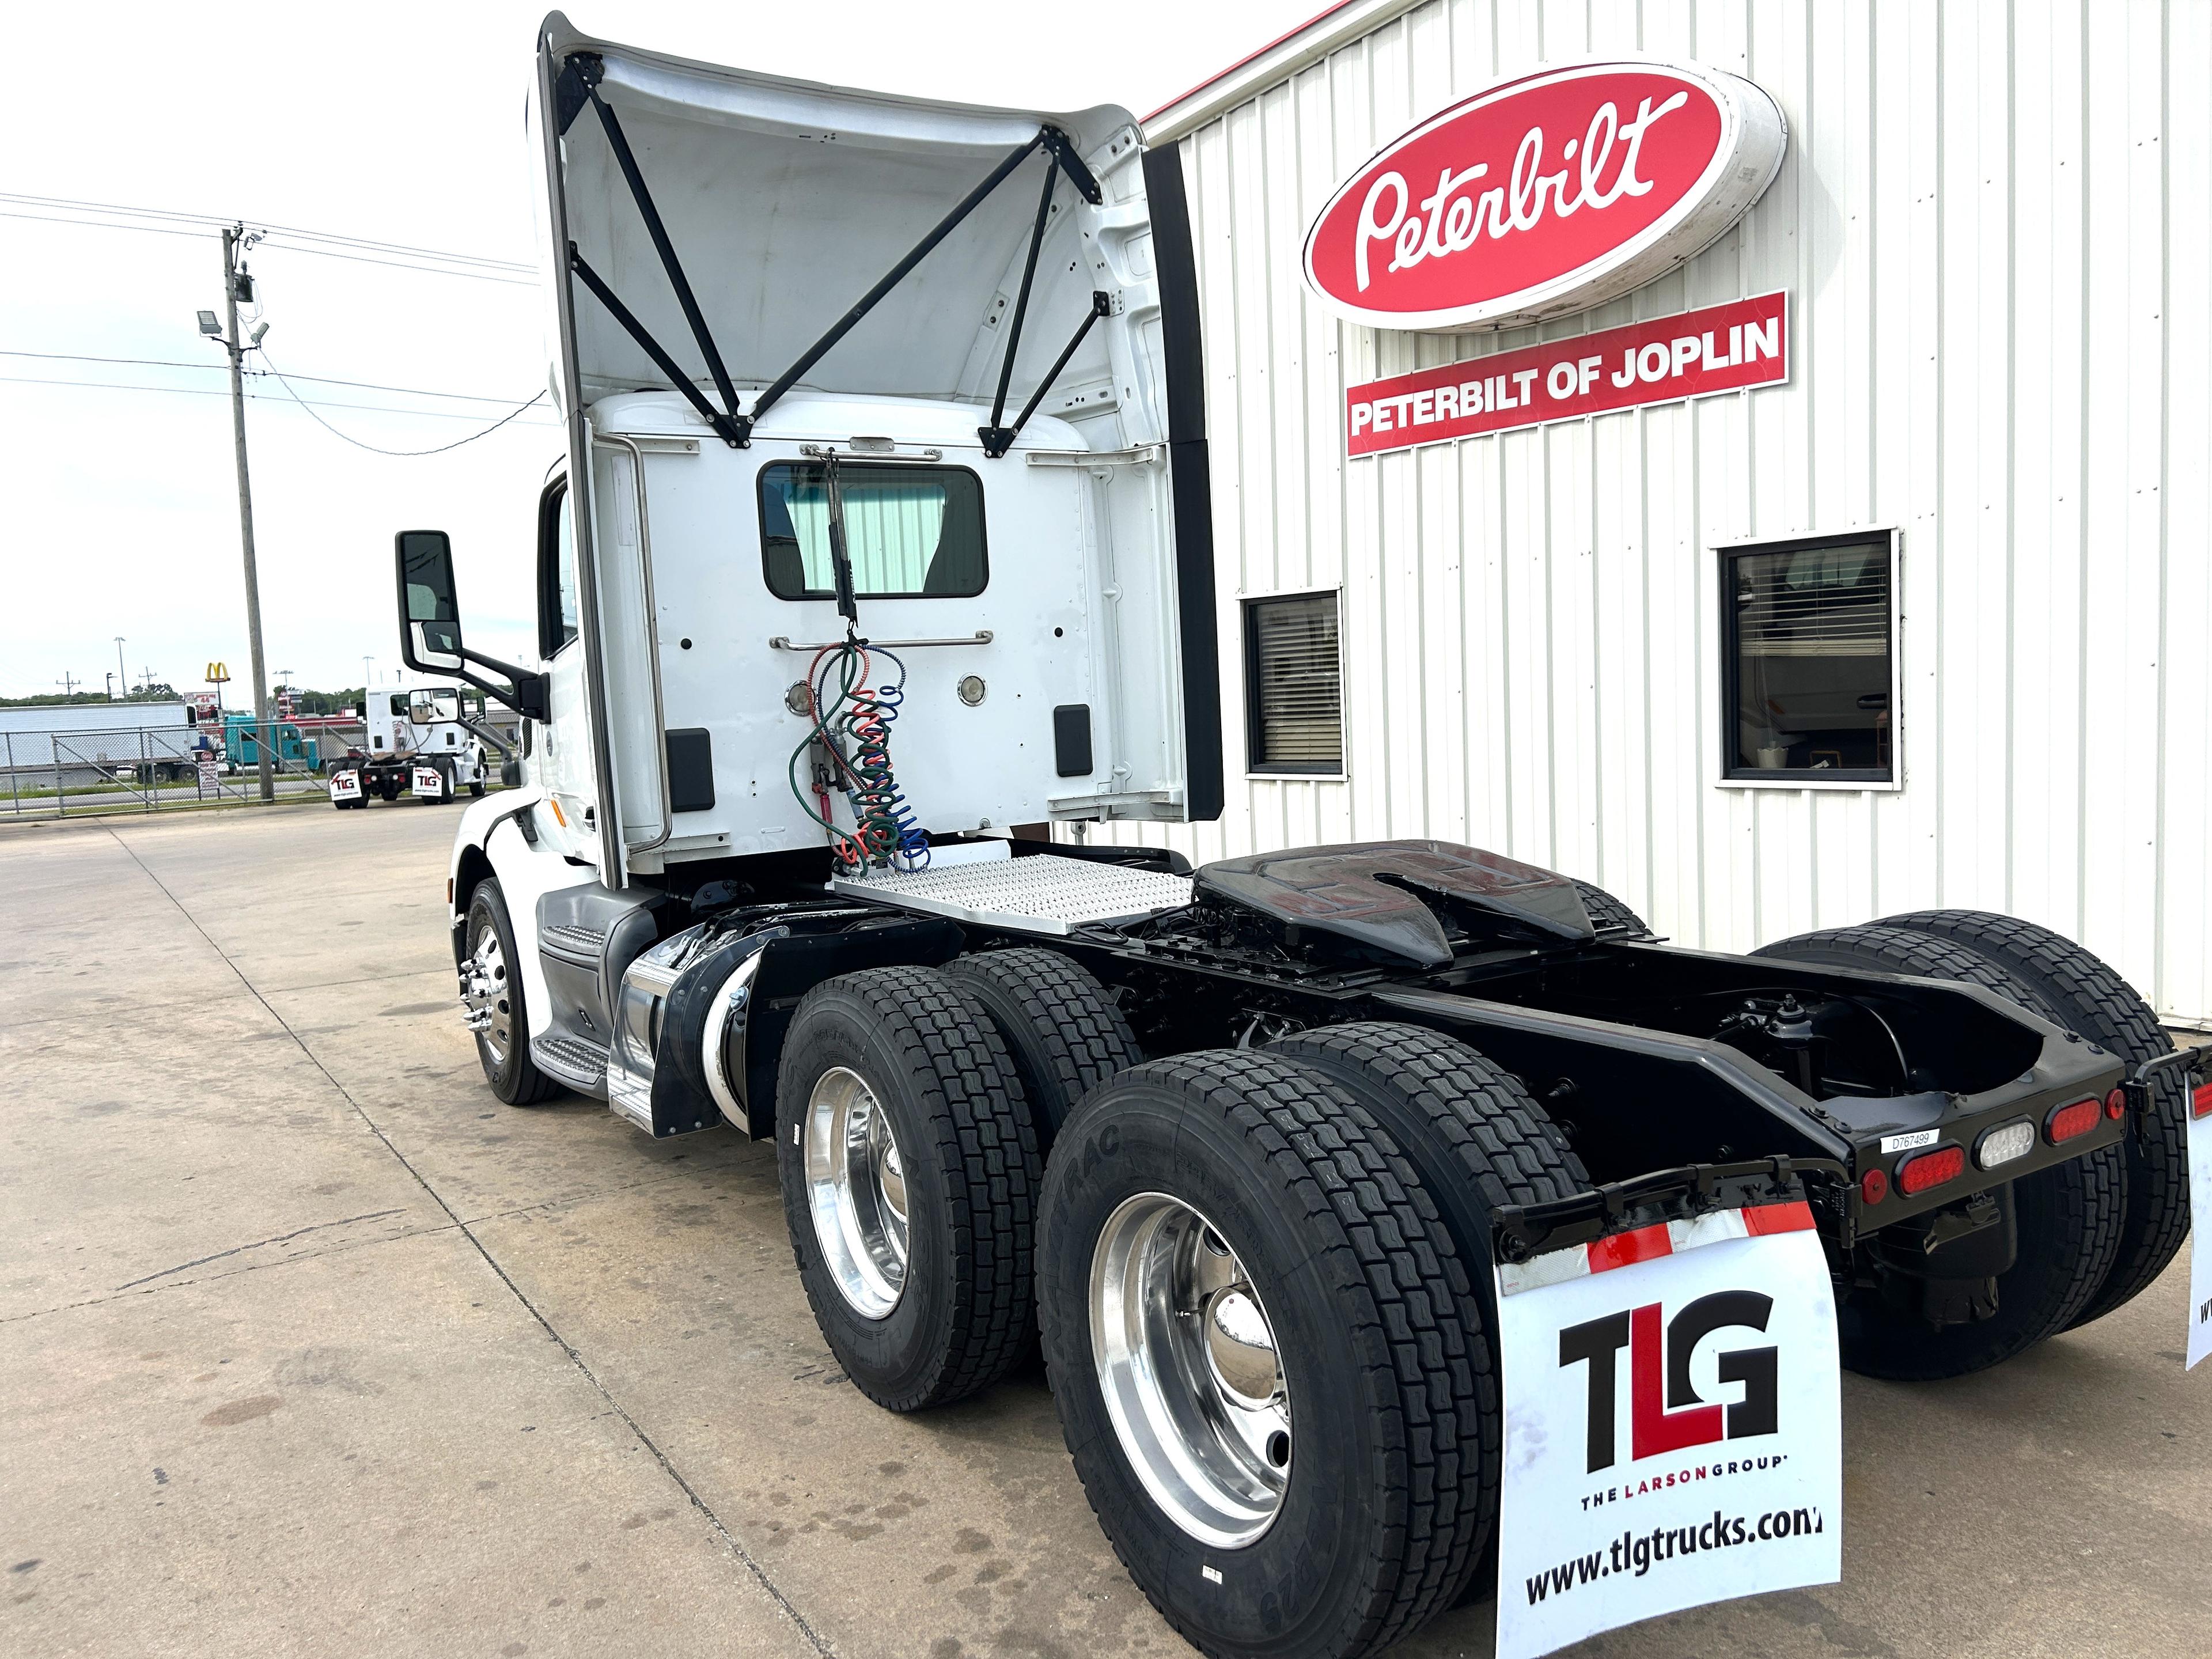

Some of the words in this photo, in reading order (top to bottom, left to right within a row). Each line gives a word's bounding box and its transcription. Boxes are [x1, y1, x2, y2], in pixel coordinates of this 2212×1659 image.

[1357, 90, 1689, 293] Peterbilt
[1351, 369, 1537, 437] PETERBILT
[1547, 355, 1603, 400] OF
[1611, 318, 1779, 388] JOPLIN
[335, 778, 354, 790] TLG
[417, 775, 436, 786] TLG
[1892, 1132, 1929, 1149] D767499
[1559, 1290, 1778, 1474] TLG
[1581, 1487, 1616, 1511] THE
[1525, 1506, 1823, 1605] www.tlgtrucks.com
